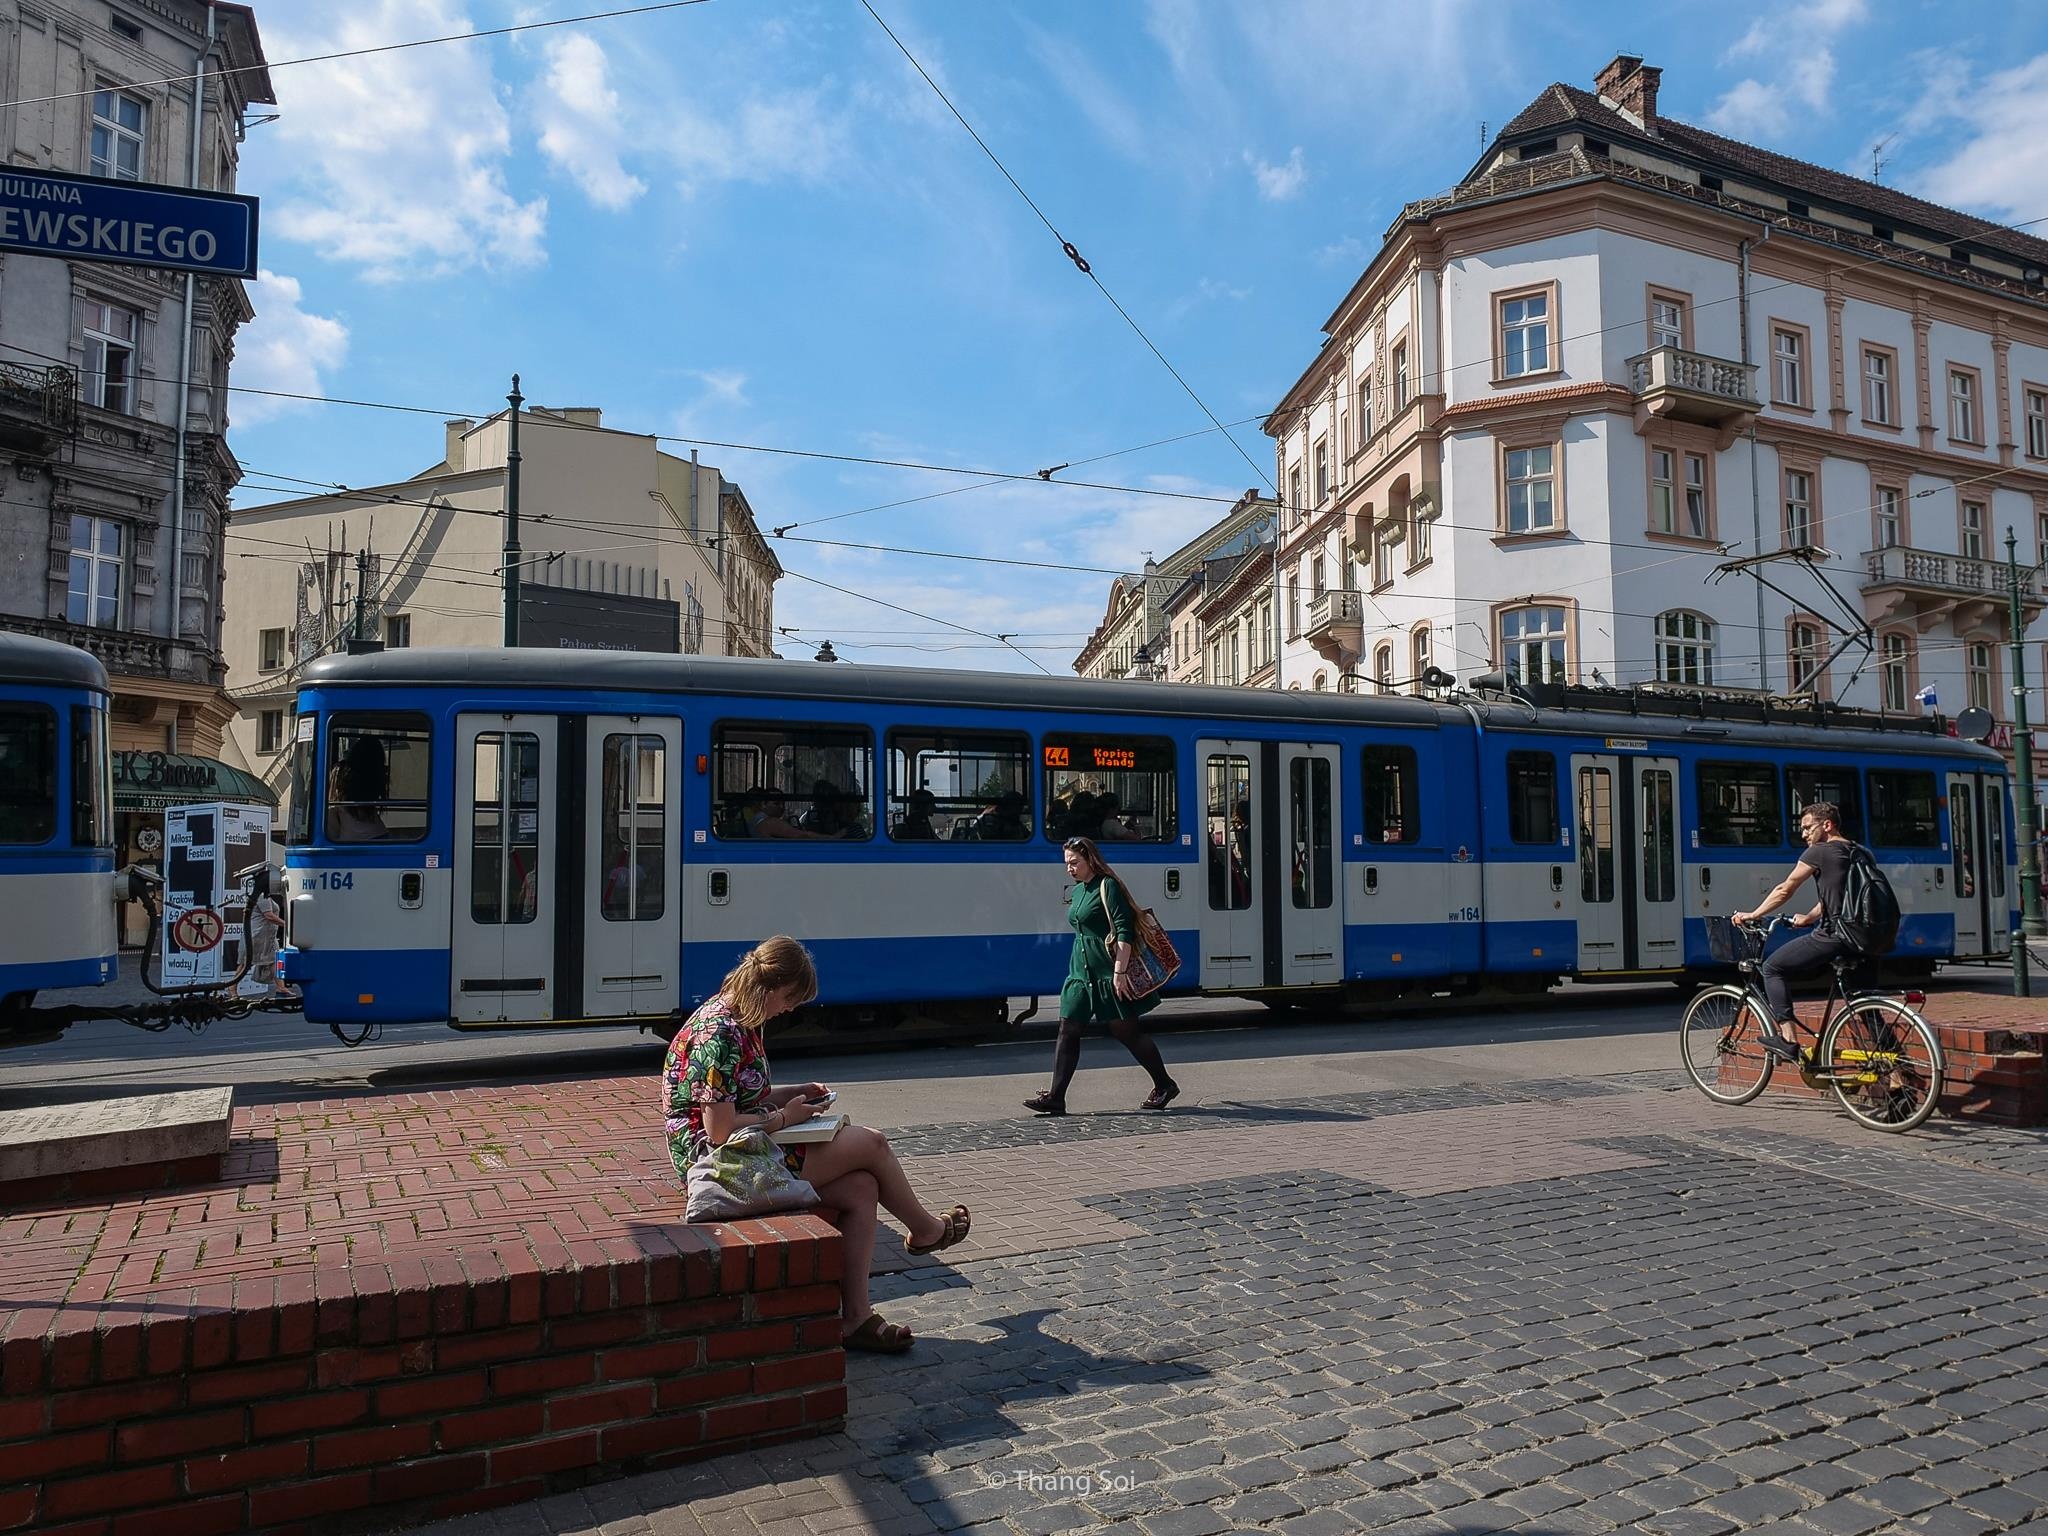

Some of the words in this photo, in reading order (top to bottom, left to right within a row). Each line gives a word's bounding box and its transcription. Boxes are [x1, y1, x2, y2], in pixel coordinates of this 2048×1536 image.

[0, 206, 217, 262] EWSKIEGO
[1046, 748, 1068, 765] 44
[1094, 748, 1135, 758] Kopiec
[1096, 758, 1134, 767] Wandy
[147, 751, 216, 788] BROWAR
[225, 832, 249, 843] Festival
[188, 848, 214, 859] Festival
[302, 879, 317, 890] HW
[320, 872, 354, 890] 164
[1460, 907, 1480, 921] 164
[168, 960, 192, 971] władzy
